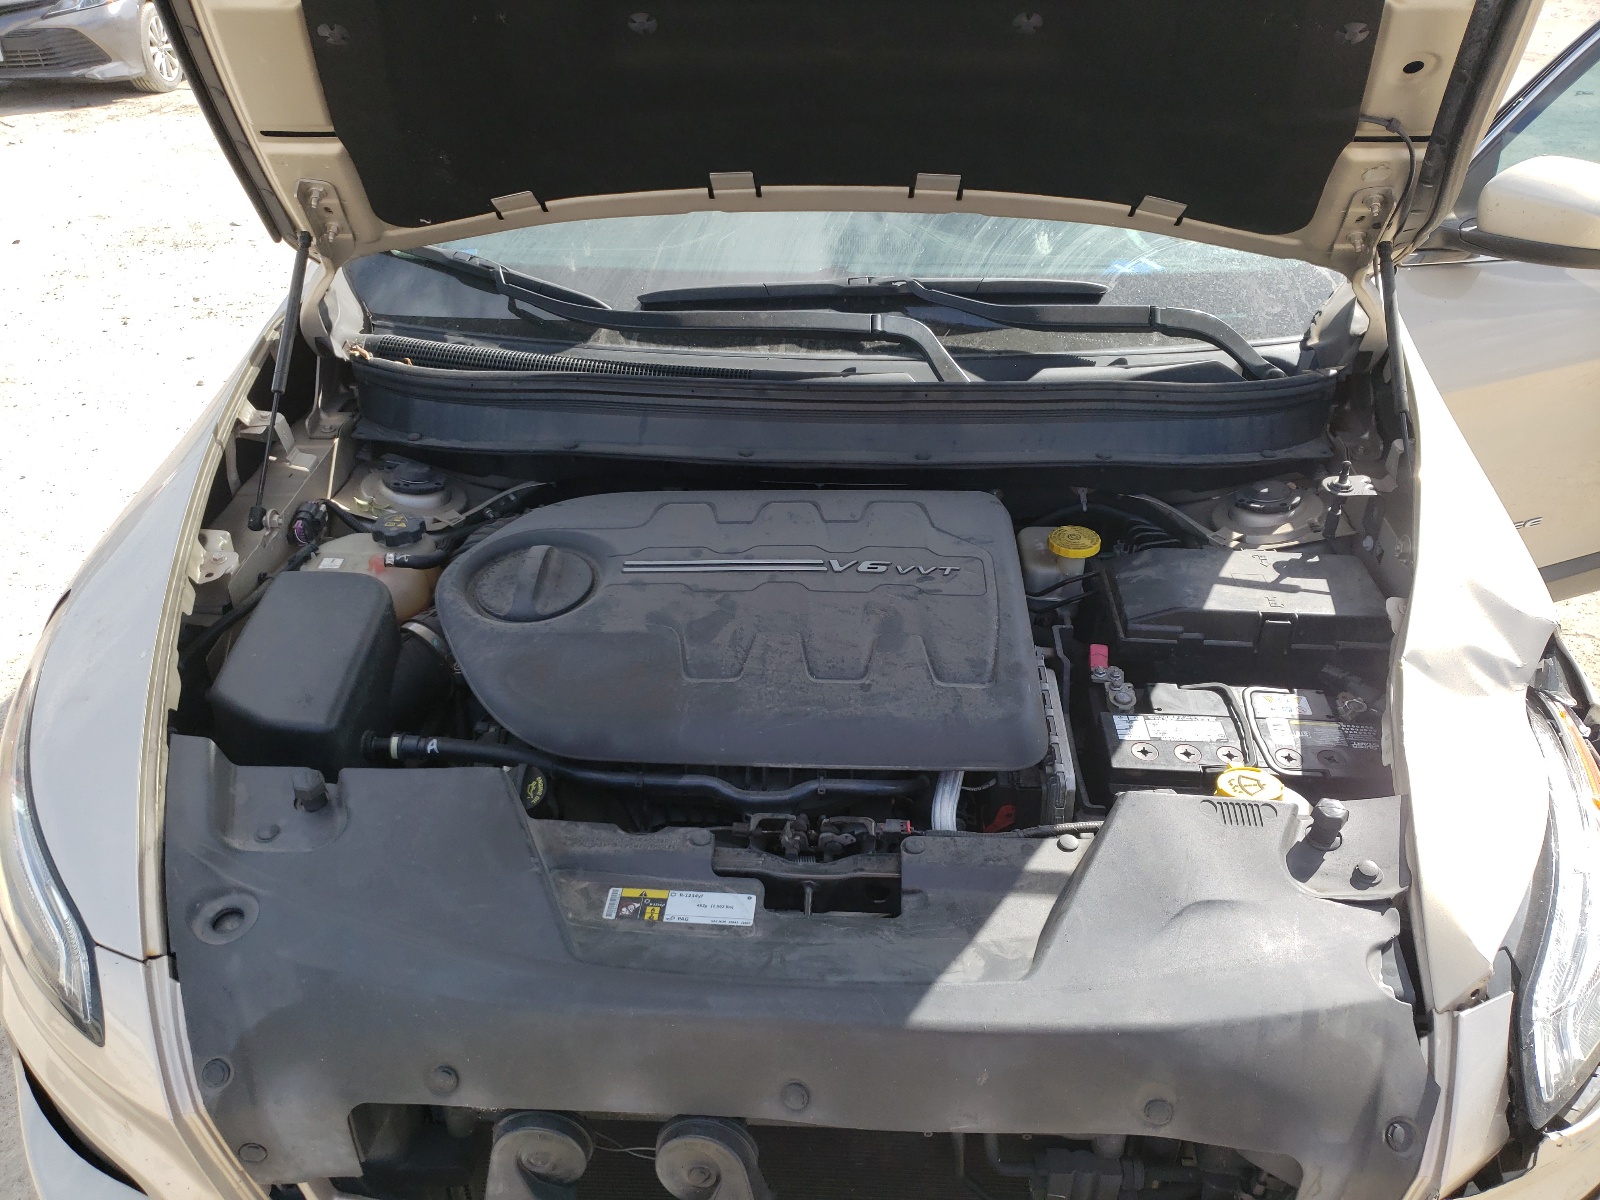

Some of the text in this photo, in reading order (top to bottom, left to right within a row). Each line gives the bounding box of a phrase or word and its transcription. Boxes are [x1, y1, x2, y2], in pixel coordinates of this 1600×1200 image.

[829, 559, 961, 576] V6 VVT
[427, 739, 439, 754] A
